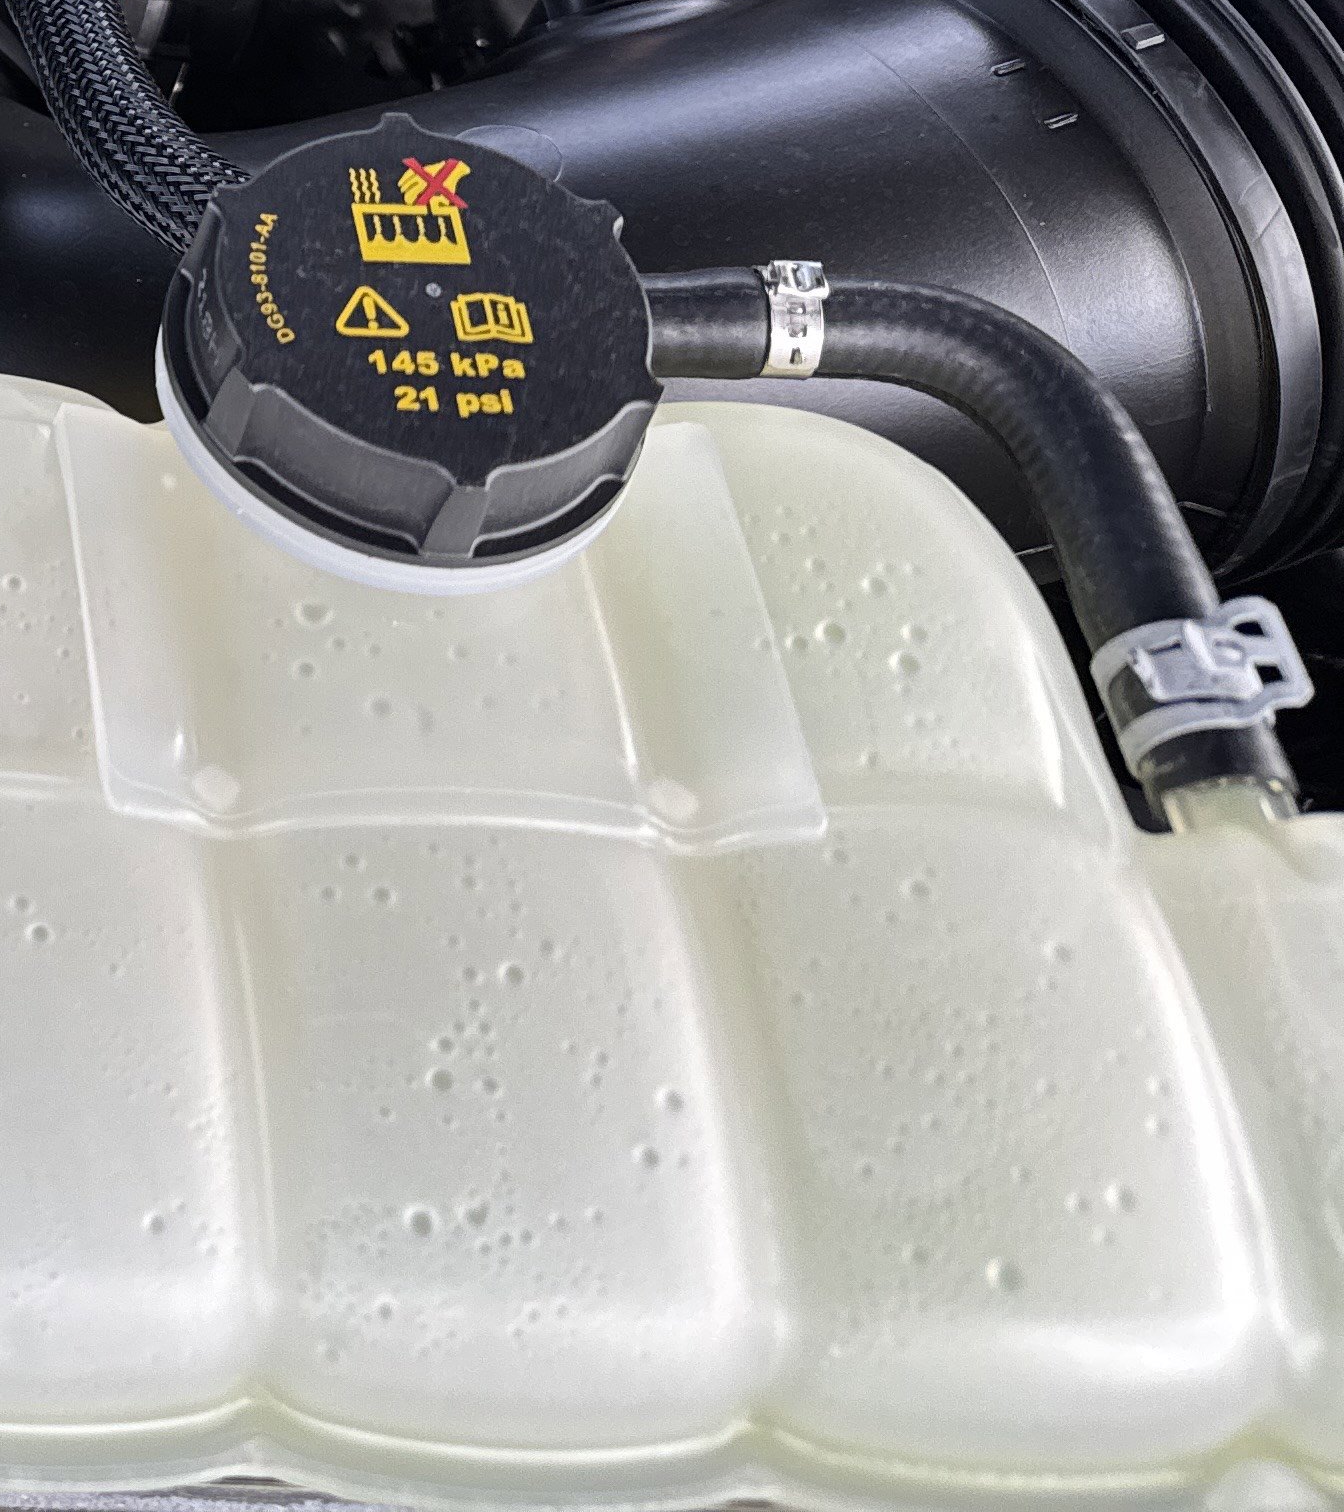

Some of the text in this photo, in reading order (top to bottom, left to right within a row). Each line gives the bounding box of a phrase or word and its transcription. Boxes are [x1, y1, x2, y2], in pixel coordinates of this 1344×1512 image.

[249, 212, 296, 345] DG93-8101-AA
[367, 349, 526, 380] 145 kPa
[394, 385, 515, 419] 21 psi
